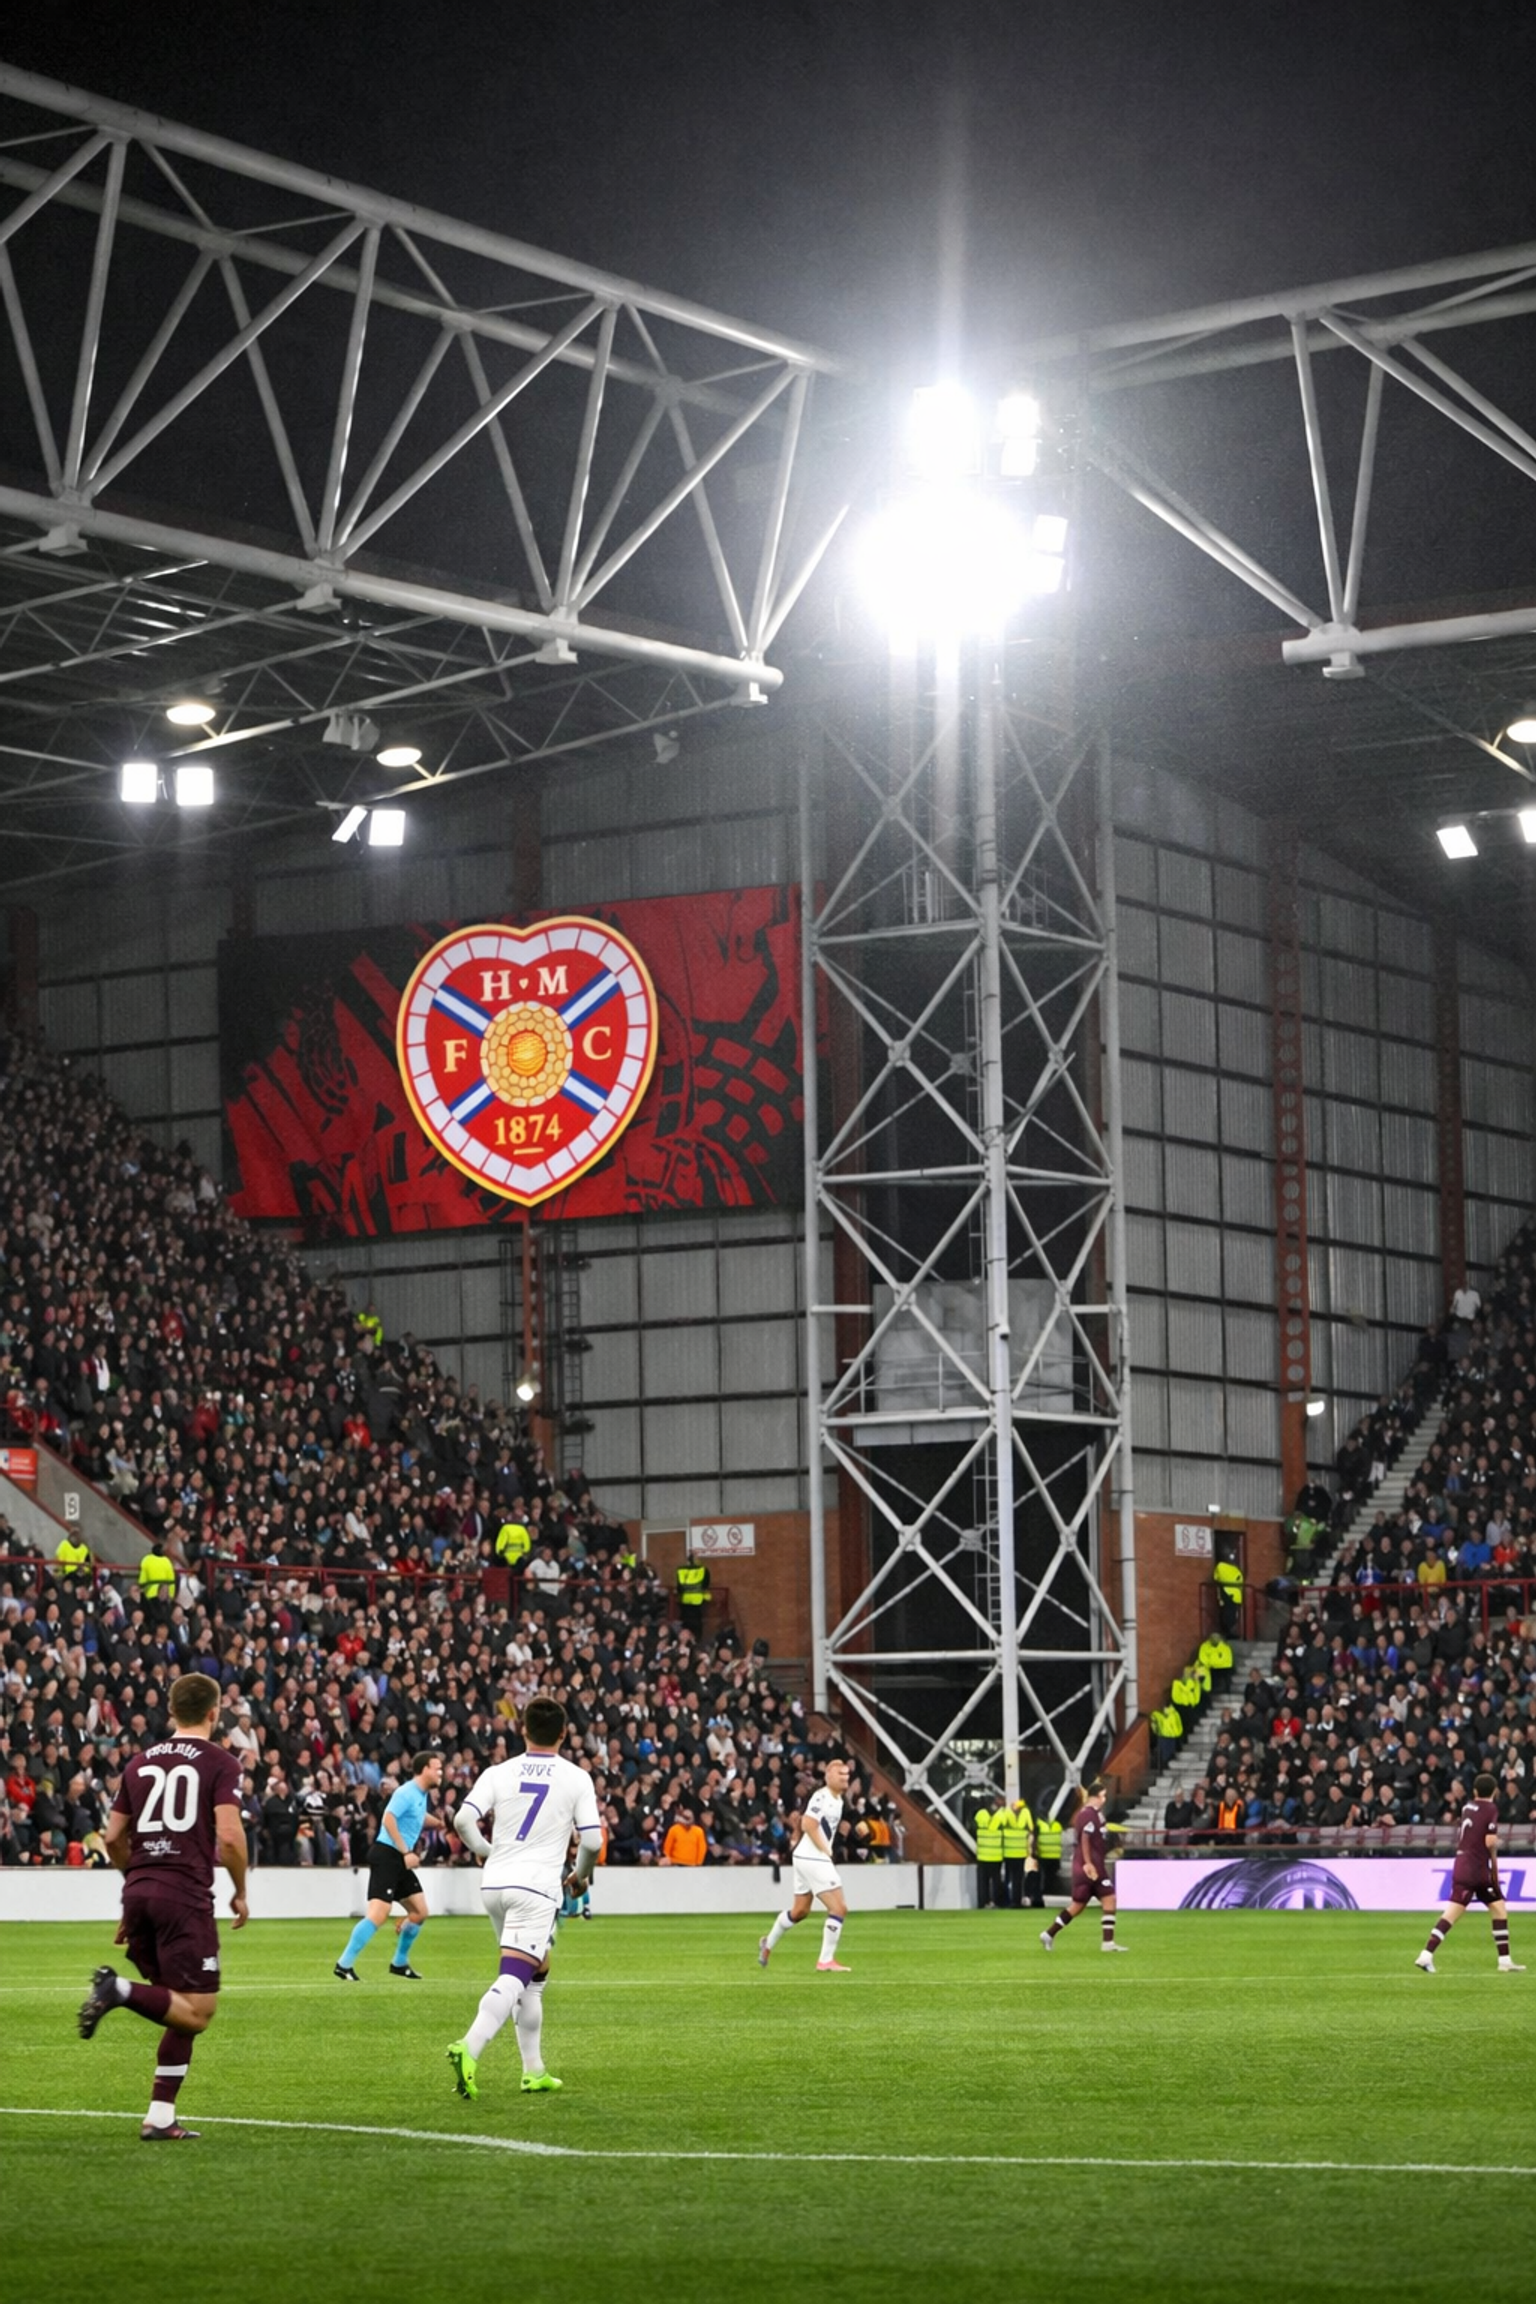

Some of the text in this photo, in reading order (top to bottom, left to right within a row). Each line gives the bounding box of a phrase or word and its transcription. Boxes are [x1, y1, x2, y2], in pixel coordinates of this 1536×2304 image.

[480, 965, 569, 1002] H M
[443, 1026, 612, 1073] F C
[494, 1113, 563, 1145] 1874
[137, 1764, 200, 1833] 20
[515, 1781, 550, 1842] 7
